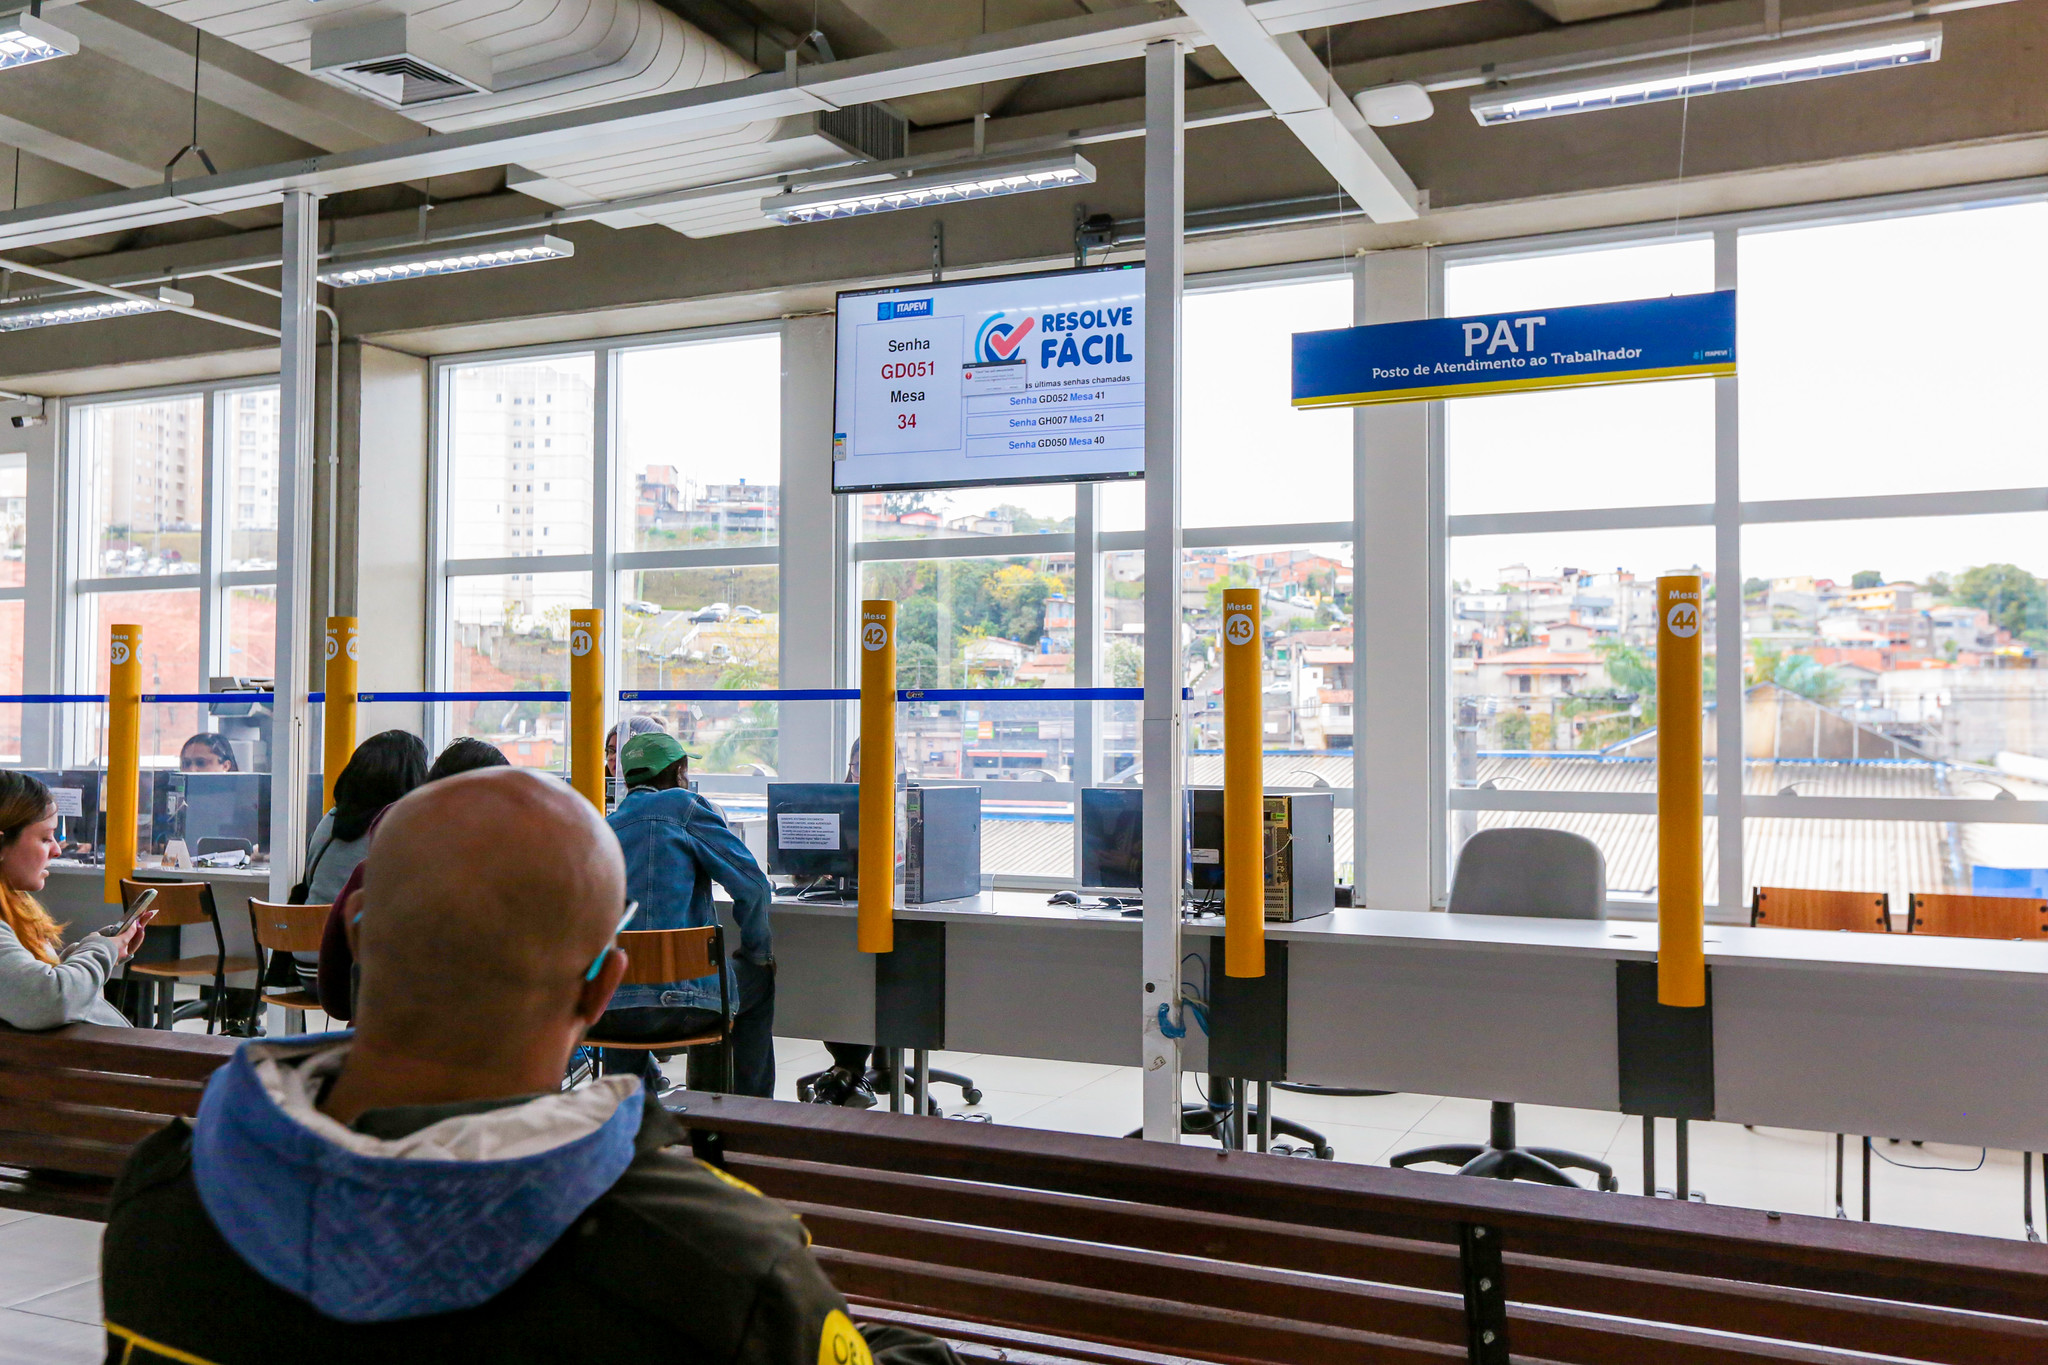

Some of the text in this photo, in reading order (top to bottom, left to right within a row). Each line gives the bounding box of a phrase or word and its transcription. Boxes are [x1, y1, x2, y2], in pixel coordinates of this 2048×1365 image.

[896, 300, 928, 313] ITAPEVI
[1041, 306, 1133, 333] RESOLVE
[1461, 316, 1547, 357] PAT
[888, 338, 930, 353] Senha
[1041, 332, 1133, 369] FÁCIL
[881, 360, 935, 380] GD051
[1372, 347, 1643, 379] Posto de Atendimento ao Trabalhador
[1035, 380, 1062, 388] últimas
[1063, 378, 1090, 387] senhas
[1092, 375, 1131, 384] chamadas
[890, 390, 925, 403] Mesa
[1009, 391, 1106, 406] Senha GD052 Mesa 41
[897, 413, 917, 430] 34
[1009, 413, 1105, 428] Senha GH007 Mesa 21
[1008, 435, 1105, 449] Senha GD050 Mesa 40
[1669, 590, 1699, 600] Mesa
[1226, 602, 1253, 611] Mesa
[863, 612, 887, 620] Mesa
[1671, 610, 1697, 630] 44
[864, 628, 884, 645] 42
[1228, 620, 1251, 639] 43
[572, 635, 588, 650] 41
[111, 647, 127, 660] 39
